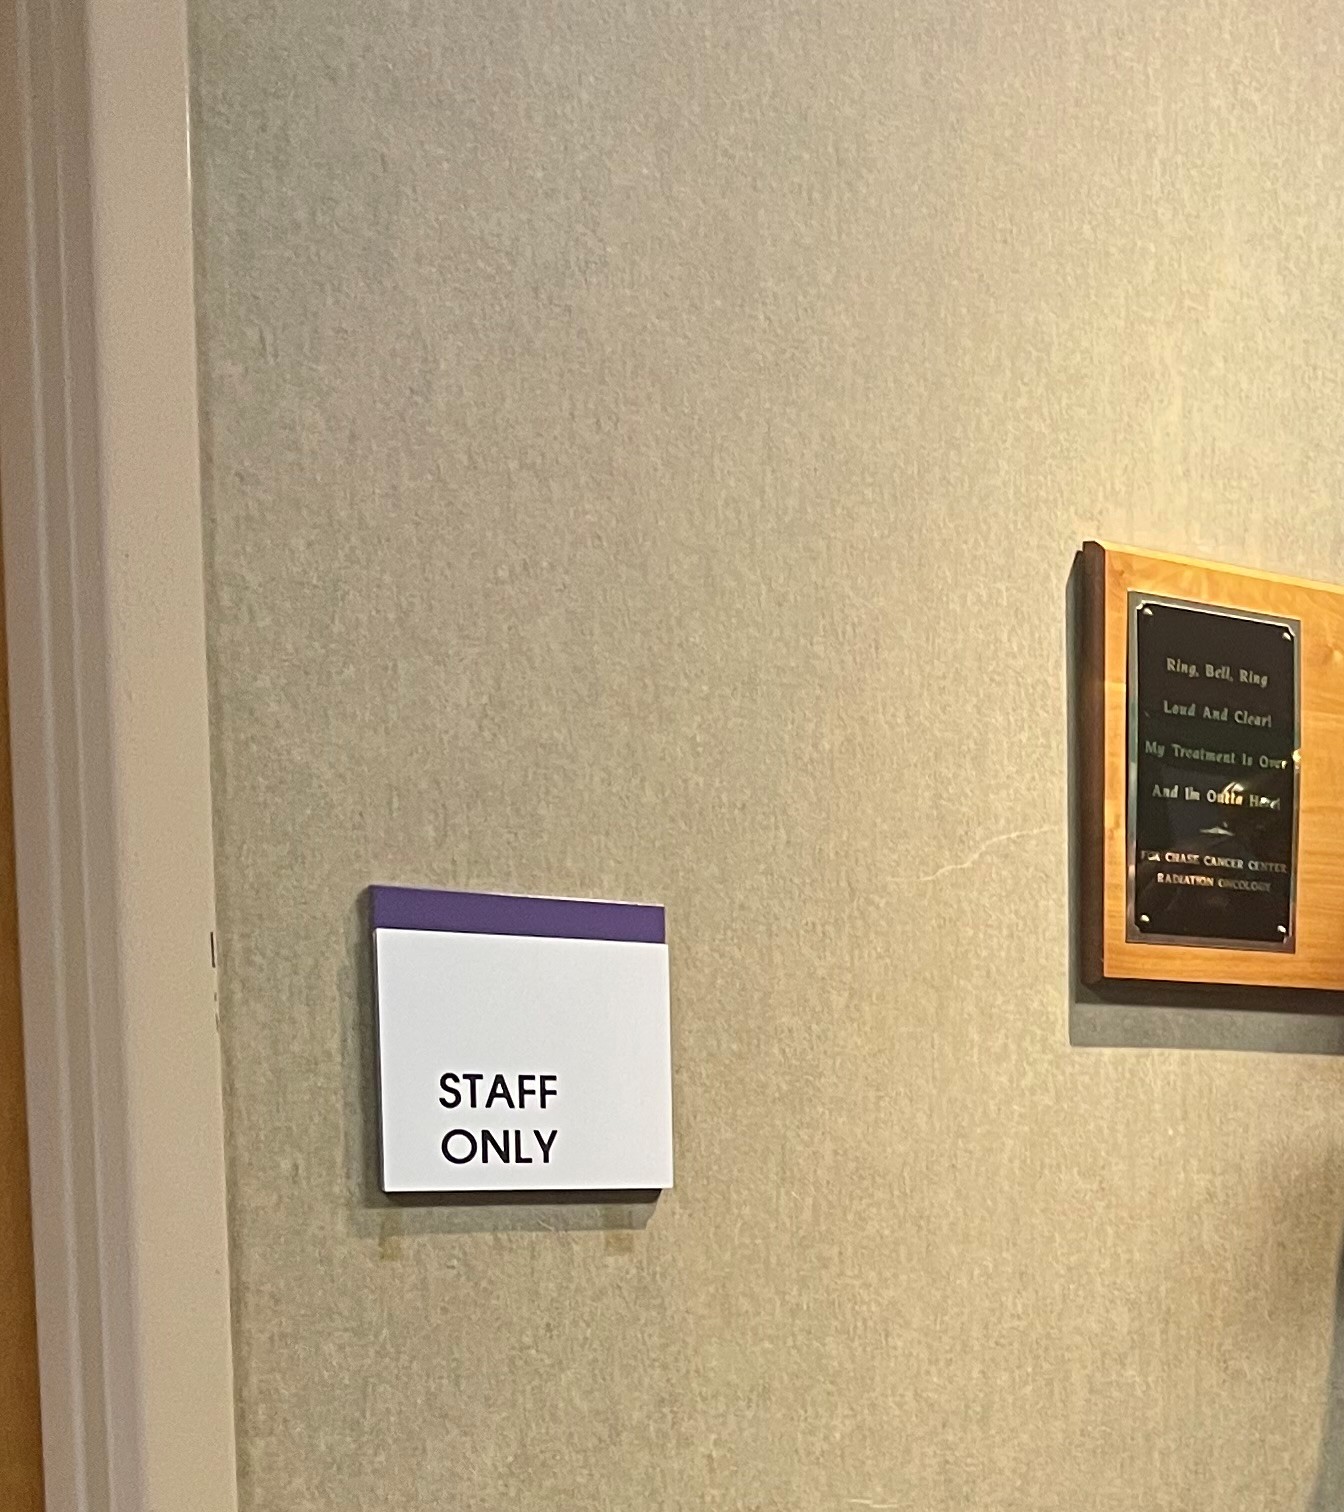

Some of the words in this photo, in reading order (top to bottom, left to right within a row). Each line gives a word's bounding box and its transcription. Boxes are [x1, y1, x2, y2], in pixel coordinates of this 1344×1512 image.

[1239, 668, 1268, 688] Ring
[1163, 700, 1196, 717] Loud
[1203, 706, 1228, 722] And
[1145, 740, 1165, 758] My
[1171, 743, 1235, 764] Treatment
[1242, 755, 1253, 766] Is
[1152, 784, 1179, 799] And
[1165, 852, 1200, 865] CHASE
[1203, 855, 1244, 870] CANCER
[1248, 860, 1288, 874] CENTER
[1157, 872, 1214, 887] RADIATION
[1218, 878, 1271, 892] ONCOLOGY
[438, 1072, 558, 1109] STAFF
[441, 1128, 558, 1165] ONLY
